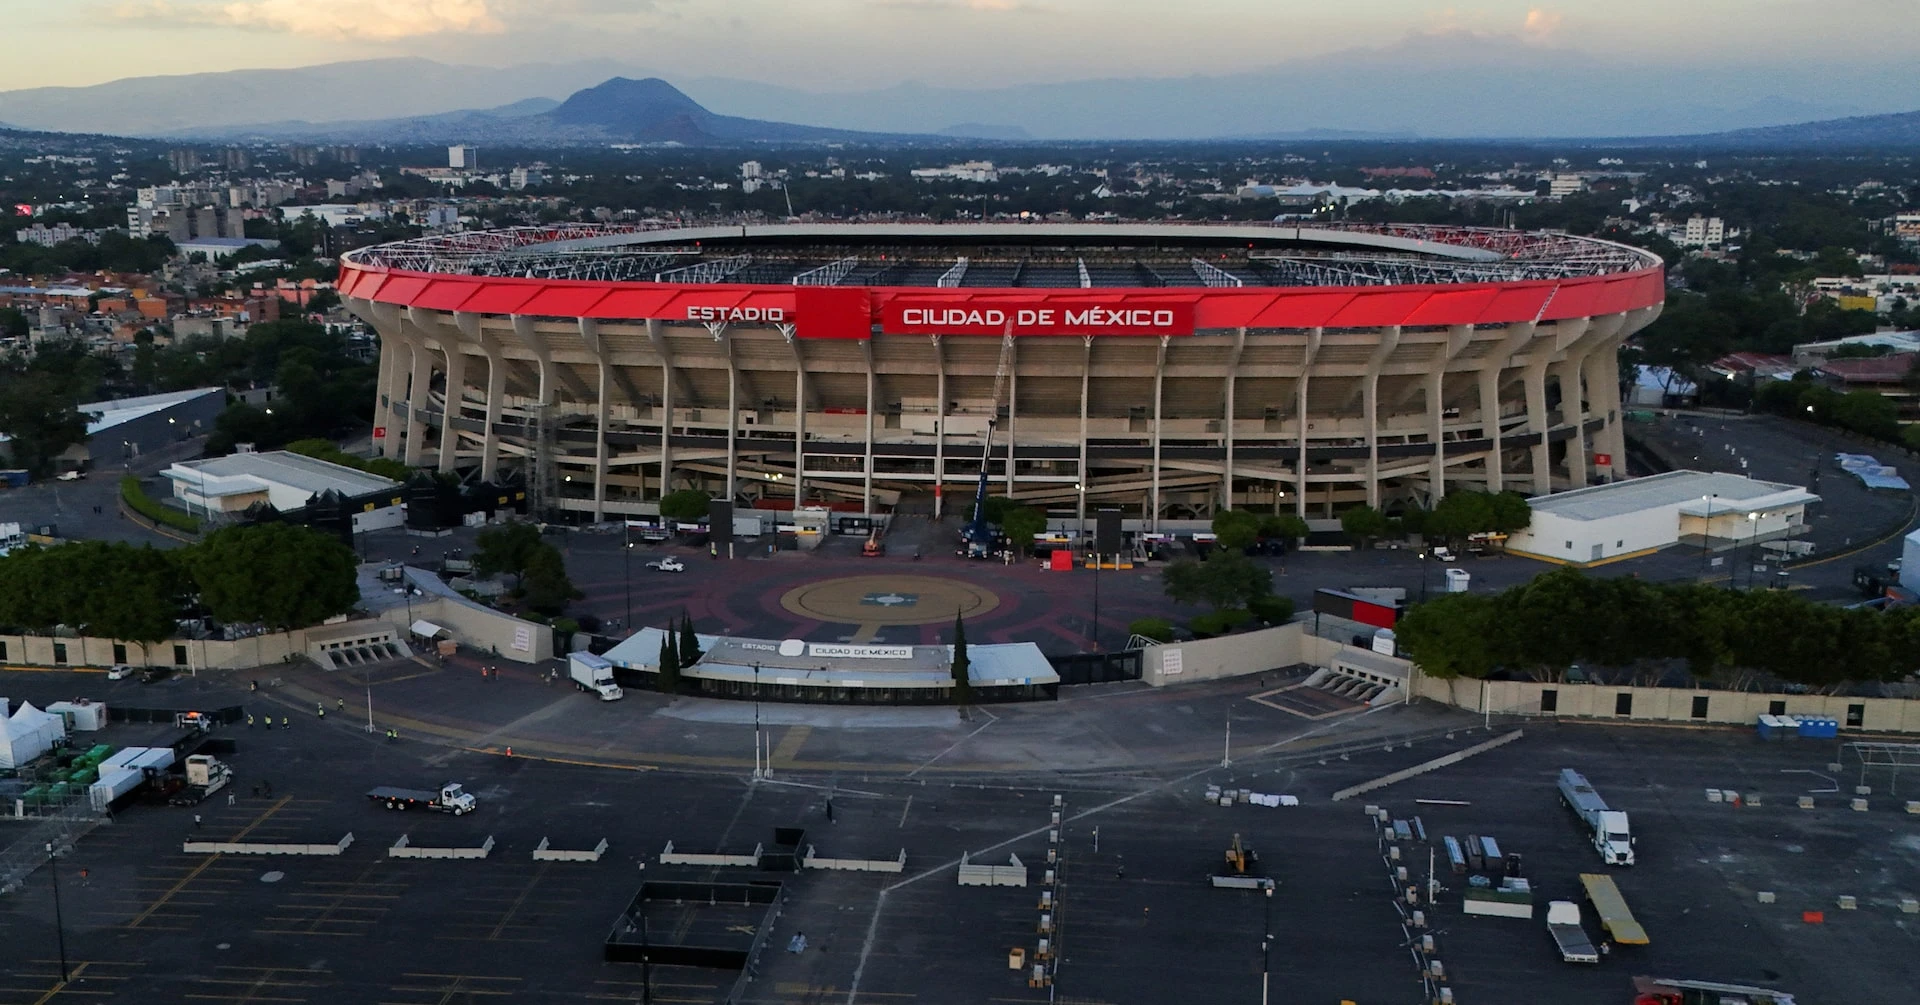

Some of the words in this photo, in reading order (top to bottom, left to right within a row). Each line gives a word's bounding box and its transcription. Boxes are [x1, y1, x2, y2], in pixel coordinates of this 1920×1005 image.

[687, 306, 784, 321] ESTADIO
[903, 309, 1005, 326] CIUDAD
[1017, 310, 1055, 325] DE
[1065, 306, 1174, 326] MÉXICO
[742, 643, 776, 651] ESTADIO
[815, 647, 851, 655] CIUDAD
[869, 647, 907, 656] MÉXICO
